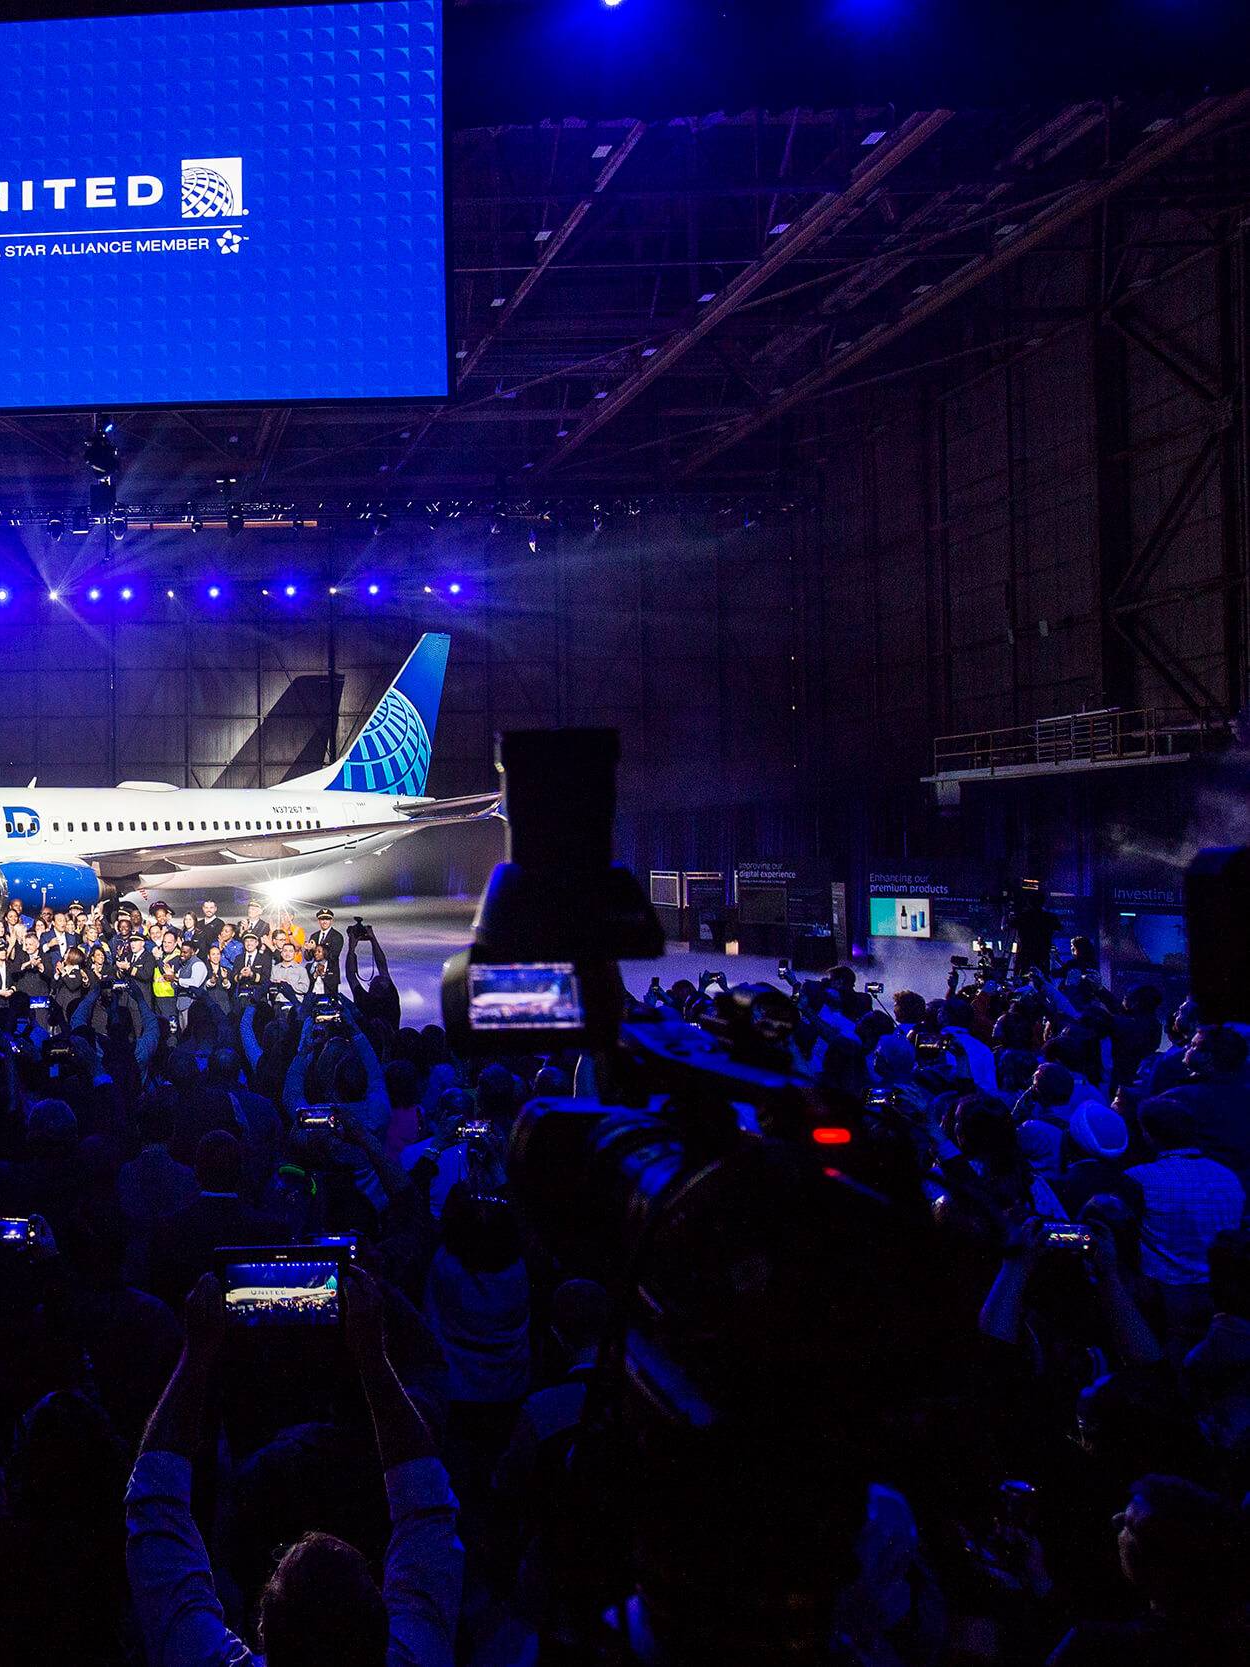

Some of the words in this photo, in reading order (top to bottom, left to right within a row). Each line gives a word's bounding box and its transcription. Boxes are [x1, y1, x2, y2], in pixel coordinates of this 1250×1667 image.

[5, 244, 46, 257] STAR
[51, 240, 132, 256] ALLIANCE
[136, 237, 209, 251] MEMBER
[272, 805, 303, 814] N37267
[914, 874, 929, 882] our
[869, 883, 908, 893] premium
[909, 884, 949, 894] products
[1113, 887, 1175, 902] Investing
